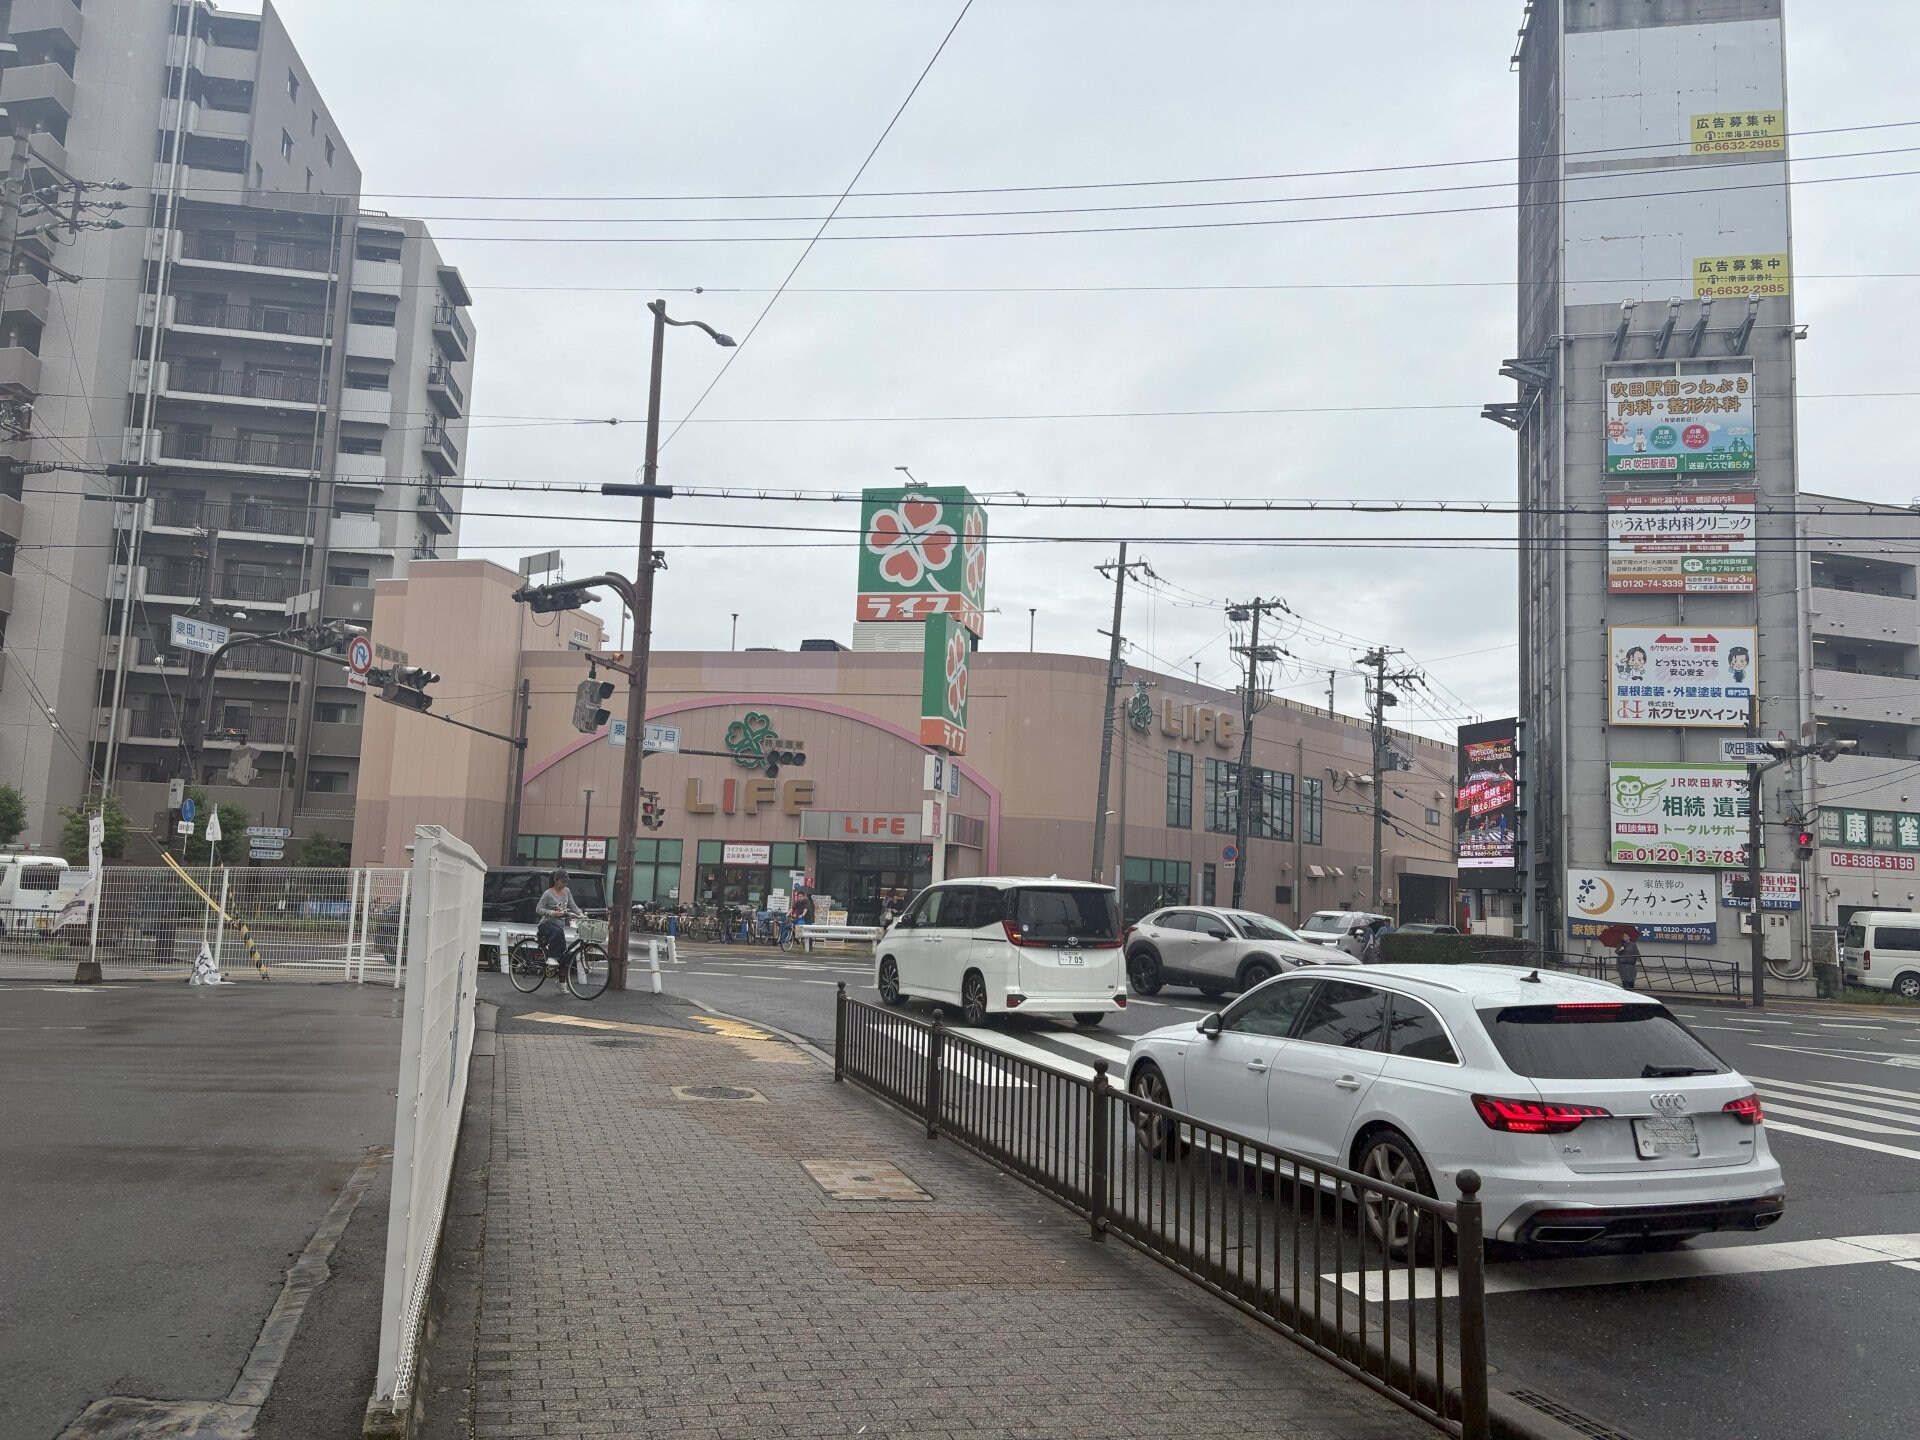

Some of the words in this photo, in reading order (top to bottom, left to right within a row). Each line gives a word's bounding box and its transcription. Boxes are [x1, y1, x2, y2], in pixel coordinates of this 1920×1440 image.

[1696, 114, 1776, 129] 広告募集中
[1695, 139, 1780, 152] 06-6632-2985
[1699, 258, 1780, 273] 広告募集中
[1697, 284, 1784, 296] 06-6632-2985
[1611, 377, 1749, 398] 吹田駅前つわぶき
[1617, 395, 1741, 416] 内科・整形外科
[1688, 461, 1750, 470] 送迎バスで約5分
[1624, 516, 1751, 532] うえやま内科クリニック
[867, 597, 950, 618] ライフ
[962, 600, 982, 634] ライフ
[176, 621, 225, 643] 泉町1丁目
[1655, 658, 1719, 667] どっちにいっても
[1669, 668, 1704, 676] 安心安全
[1617, 686, 1722, 698] 屋根塗装・外壁塗装
[1648, 708, 1749, 720] ホクセツペイント
[1160, 698, 1235, 749] LIFE
[614, 724, 675, 742] 泉1丁目
[943, 724, 964, 752] ライフ
[1670, 778, 1736, 789] JR吹田駅す
[687, 777, 815, 815] LIFE
[1663, 796, 1705, 818] 相続
[845, 816, 905, 835] LIFE
[1617, 824, 1657, 834] 相談無料
[1819, 810, 1919, 846] 健康麻雀
[1636, 848, 1746, 863] 0120-13-783
[1832, 853, 1913, 869] 06-6386-5196
[1644, 879, 1684, 889] 家族葬の
[1621, 887, 1708, 910] みかづき
[1632, 910, 1698, 918] MIKAZUKI
